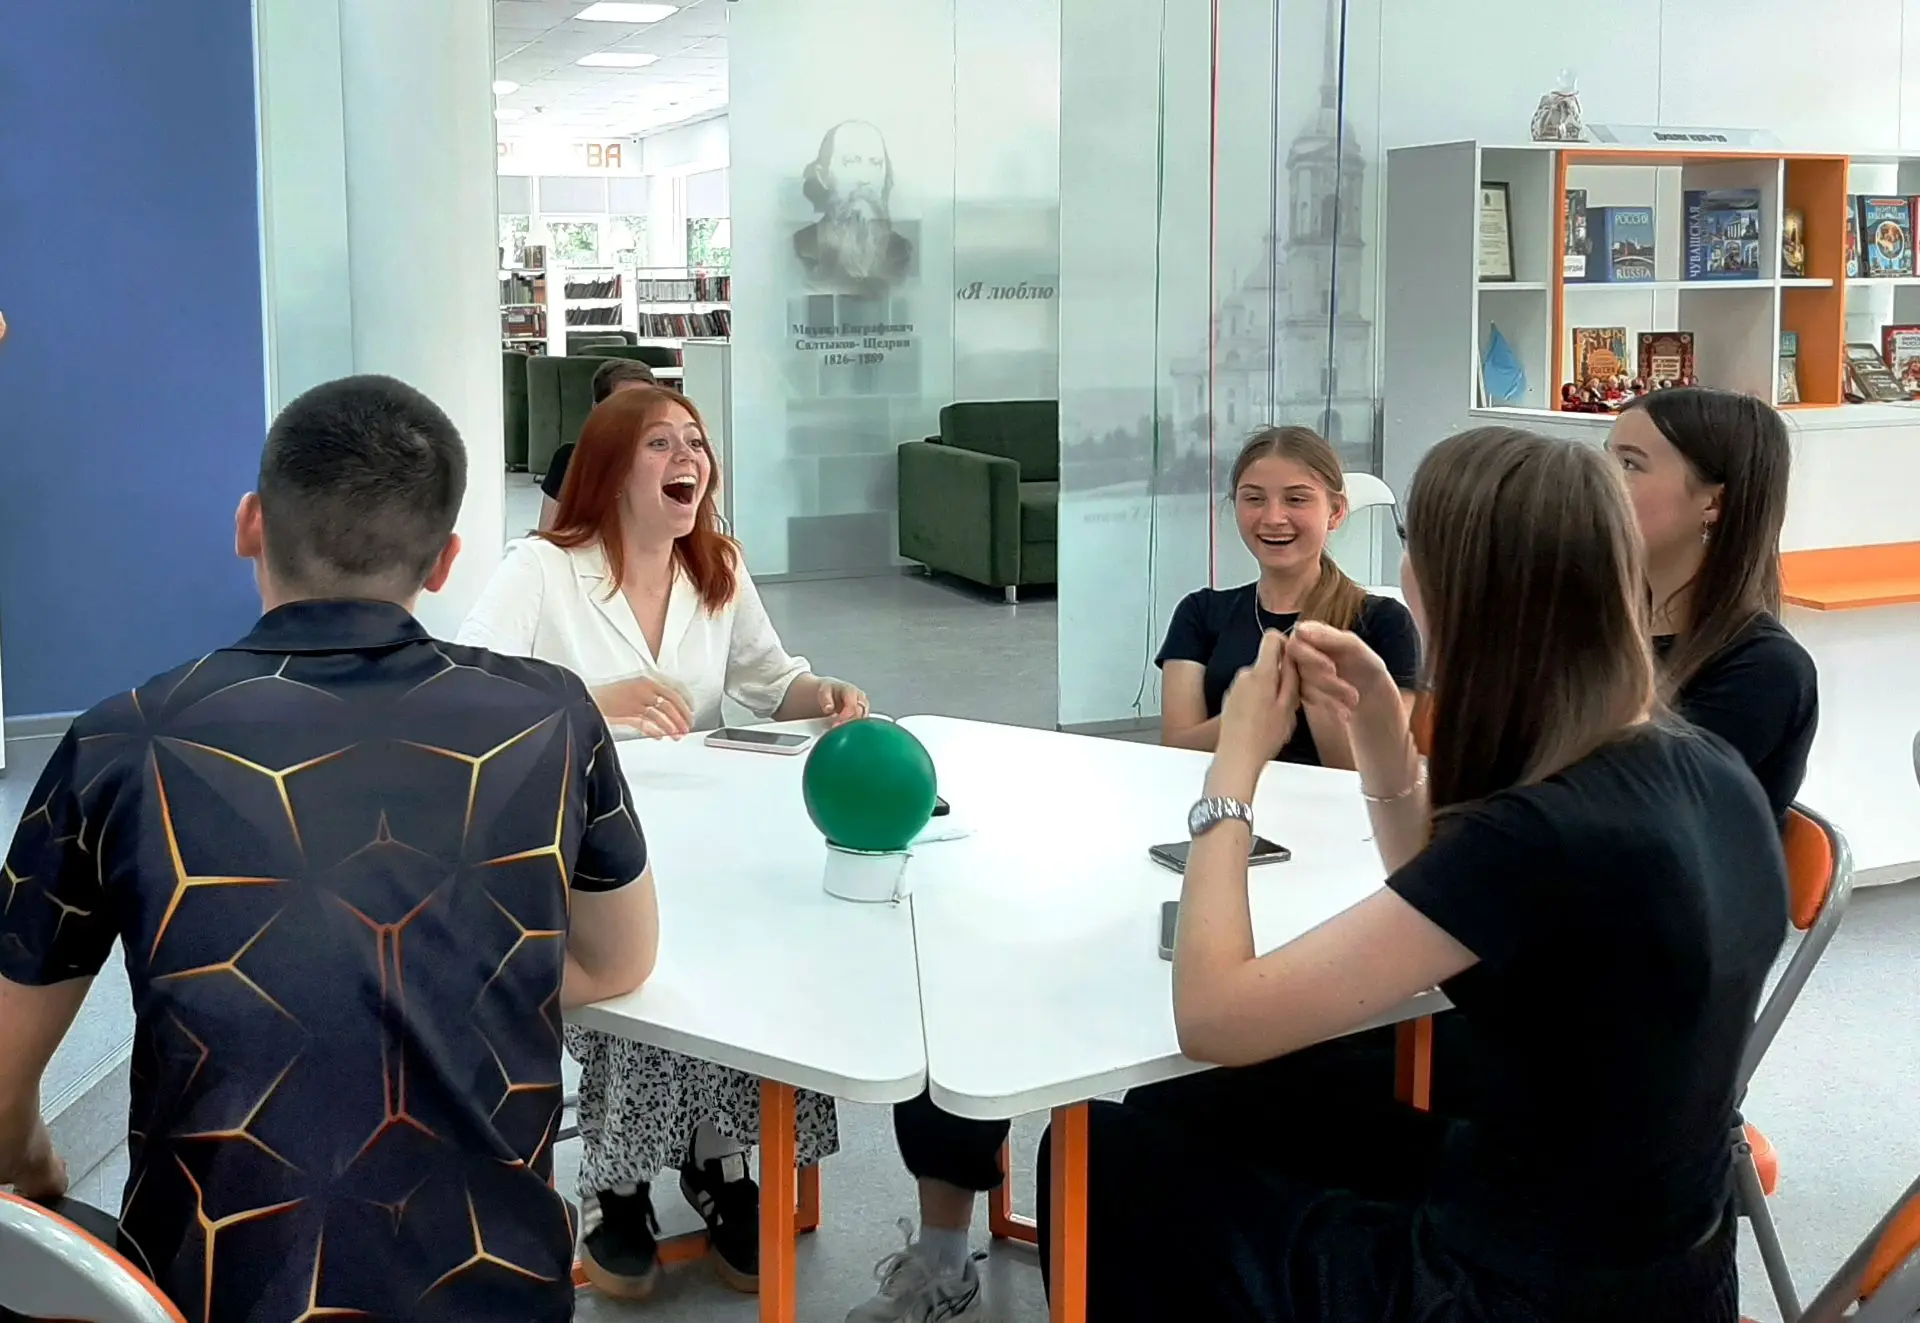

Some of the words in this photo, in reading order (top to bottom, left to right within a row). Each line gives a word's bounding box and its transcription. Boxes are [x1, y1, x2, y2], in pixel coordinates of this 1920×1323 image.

[1689, 206, 1701, 278] ЧУВАШСКАЯ
[1616, 268, 1651, 280] RUSSIA
[987, 282, 1054, 300] люблю
